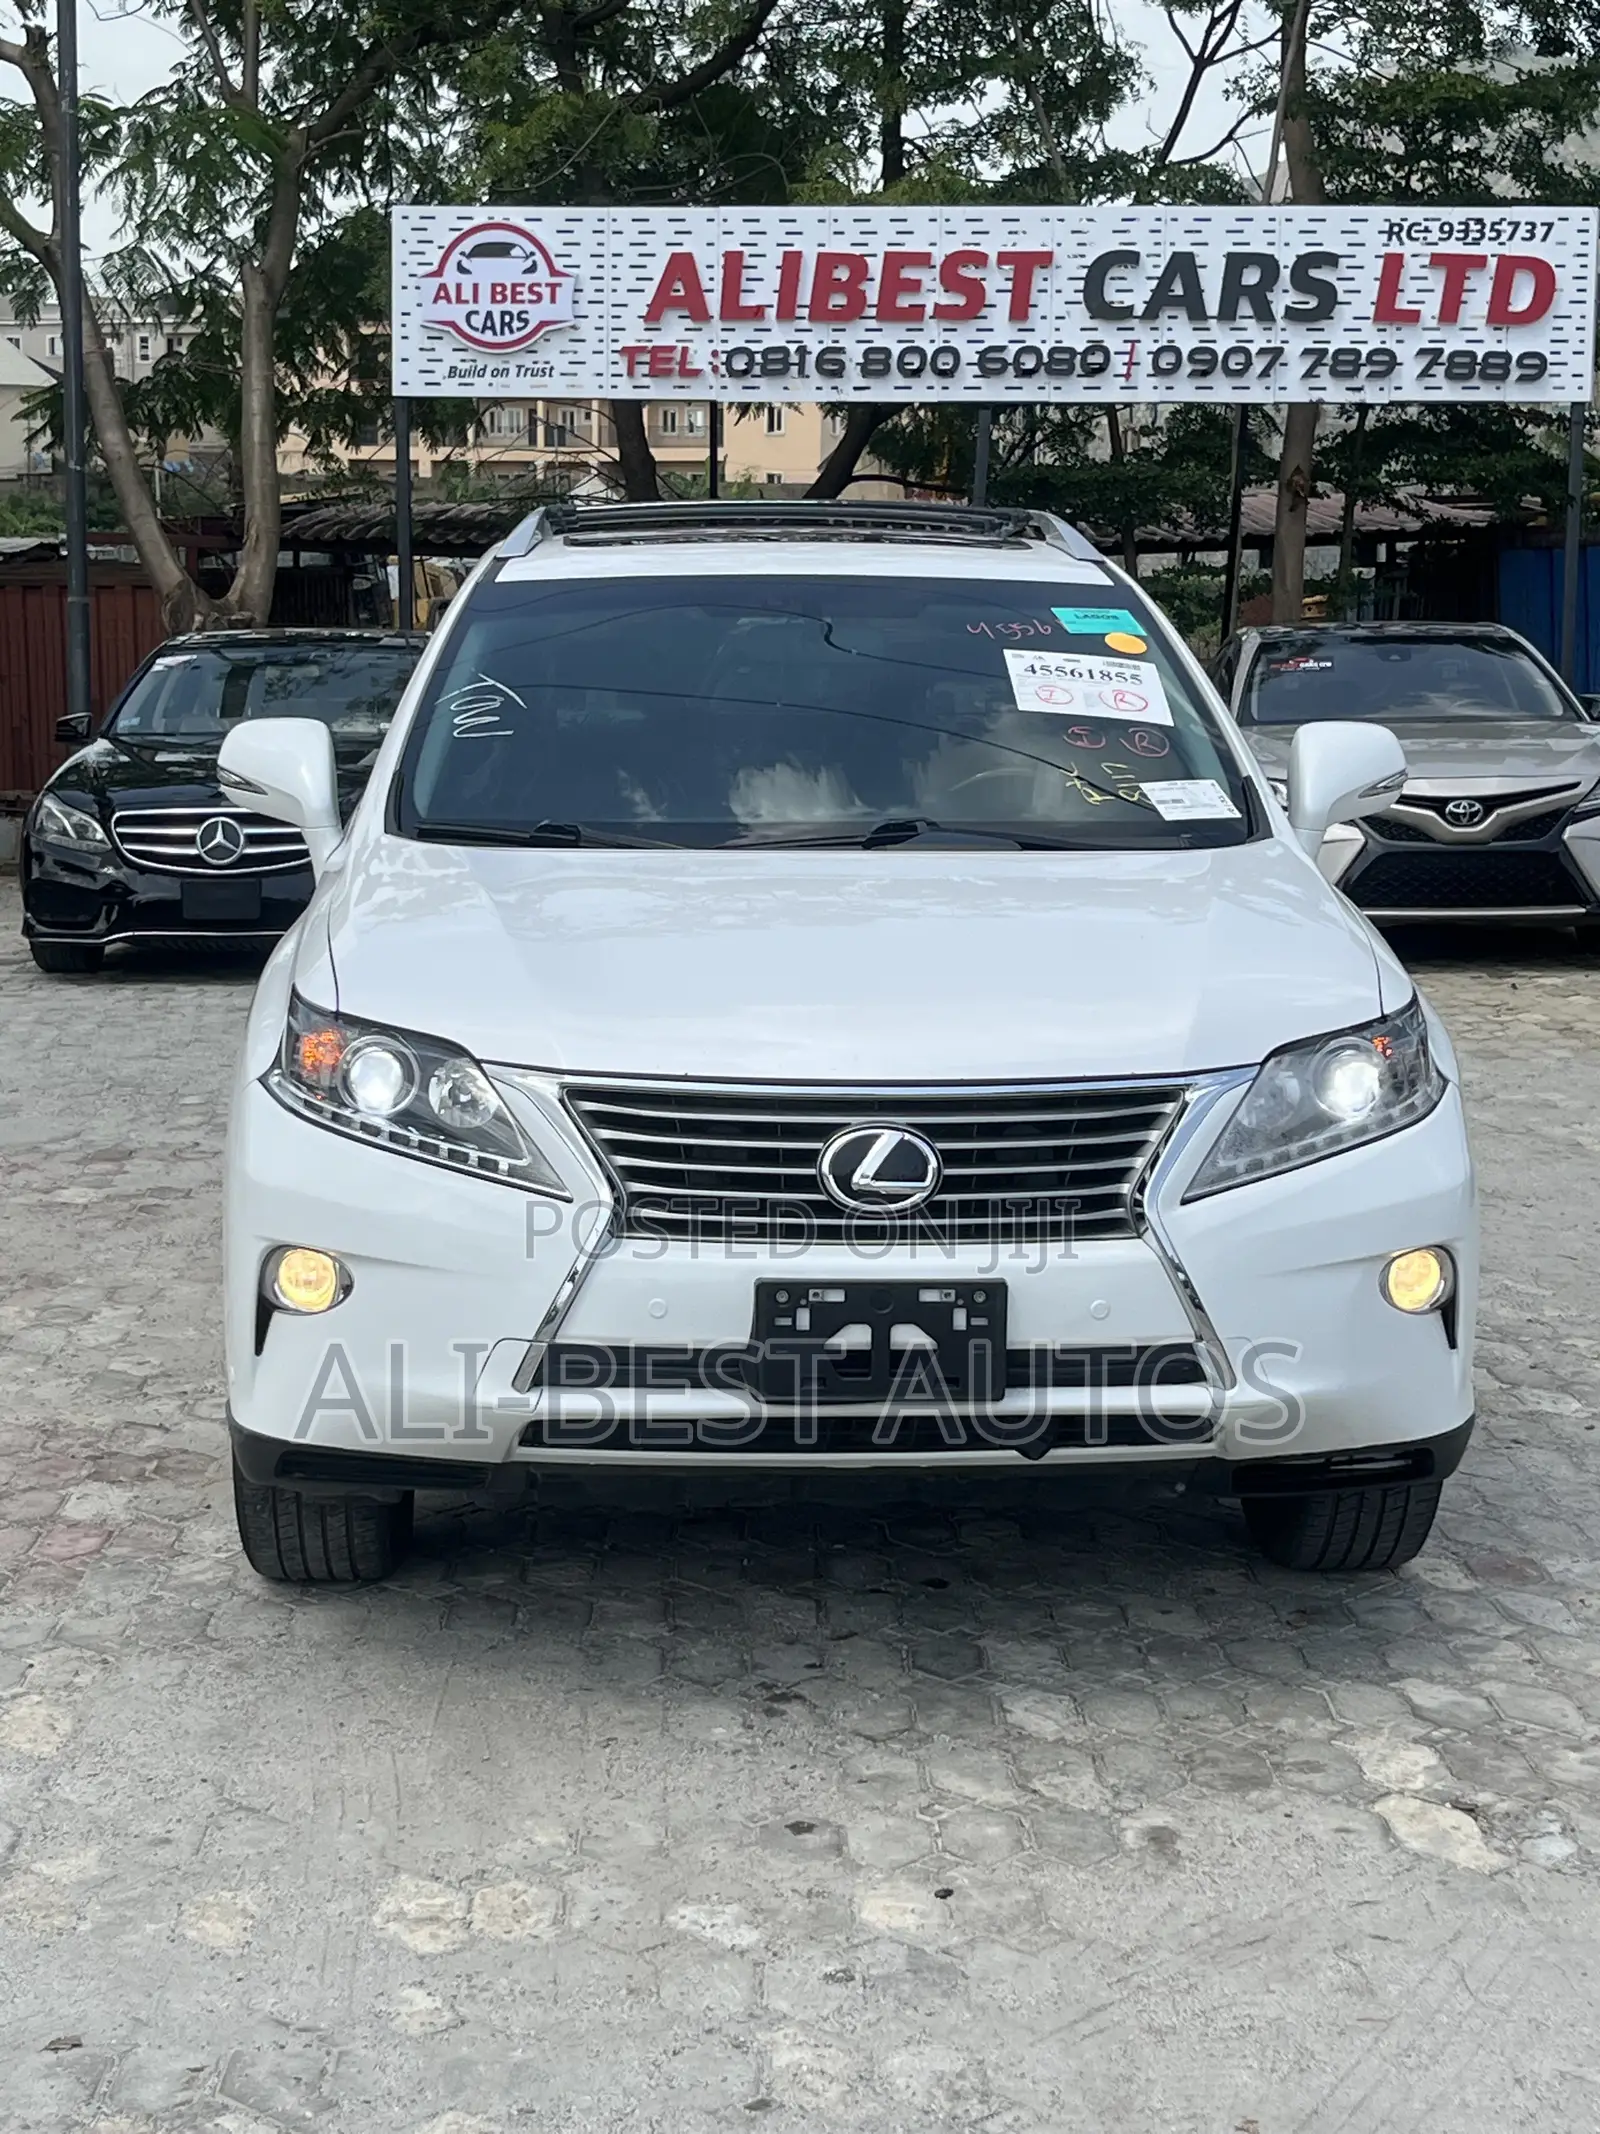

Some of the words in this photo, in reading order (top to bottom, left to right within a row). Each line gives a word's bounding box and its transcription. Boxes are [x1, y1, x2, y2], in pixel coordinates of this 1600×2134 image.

[1437, 220, 1555, 243] 9335737
[432, 282, 480, 305] ALI
[490, 282, 563, 305] BEST
[644, 250, 1053, 324] ALIBEST
[1083, 249, 1339, 322] CARS
[1373, 252, 1557, 325] LTD
[465, 310, 530, 337] CARS
[447, 363, 487, 379] Build
[490, 367, 510, 378] on
[515, 364, 555, 378] Trust
[725, 344, 847, 379] 0816
[860, 345, 960, 377] 800
[977, 345, 1110, 377] 6080
[1151, 345, 1285, 378] 0907
[1299, 347, 1398, 379] 789
[1415, 347, 1549, 382] 7889
[1024, 663, 1143, 685] 45561855
